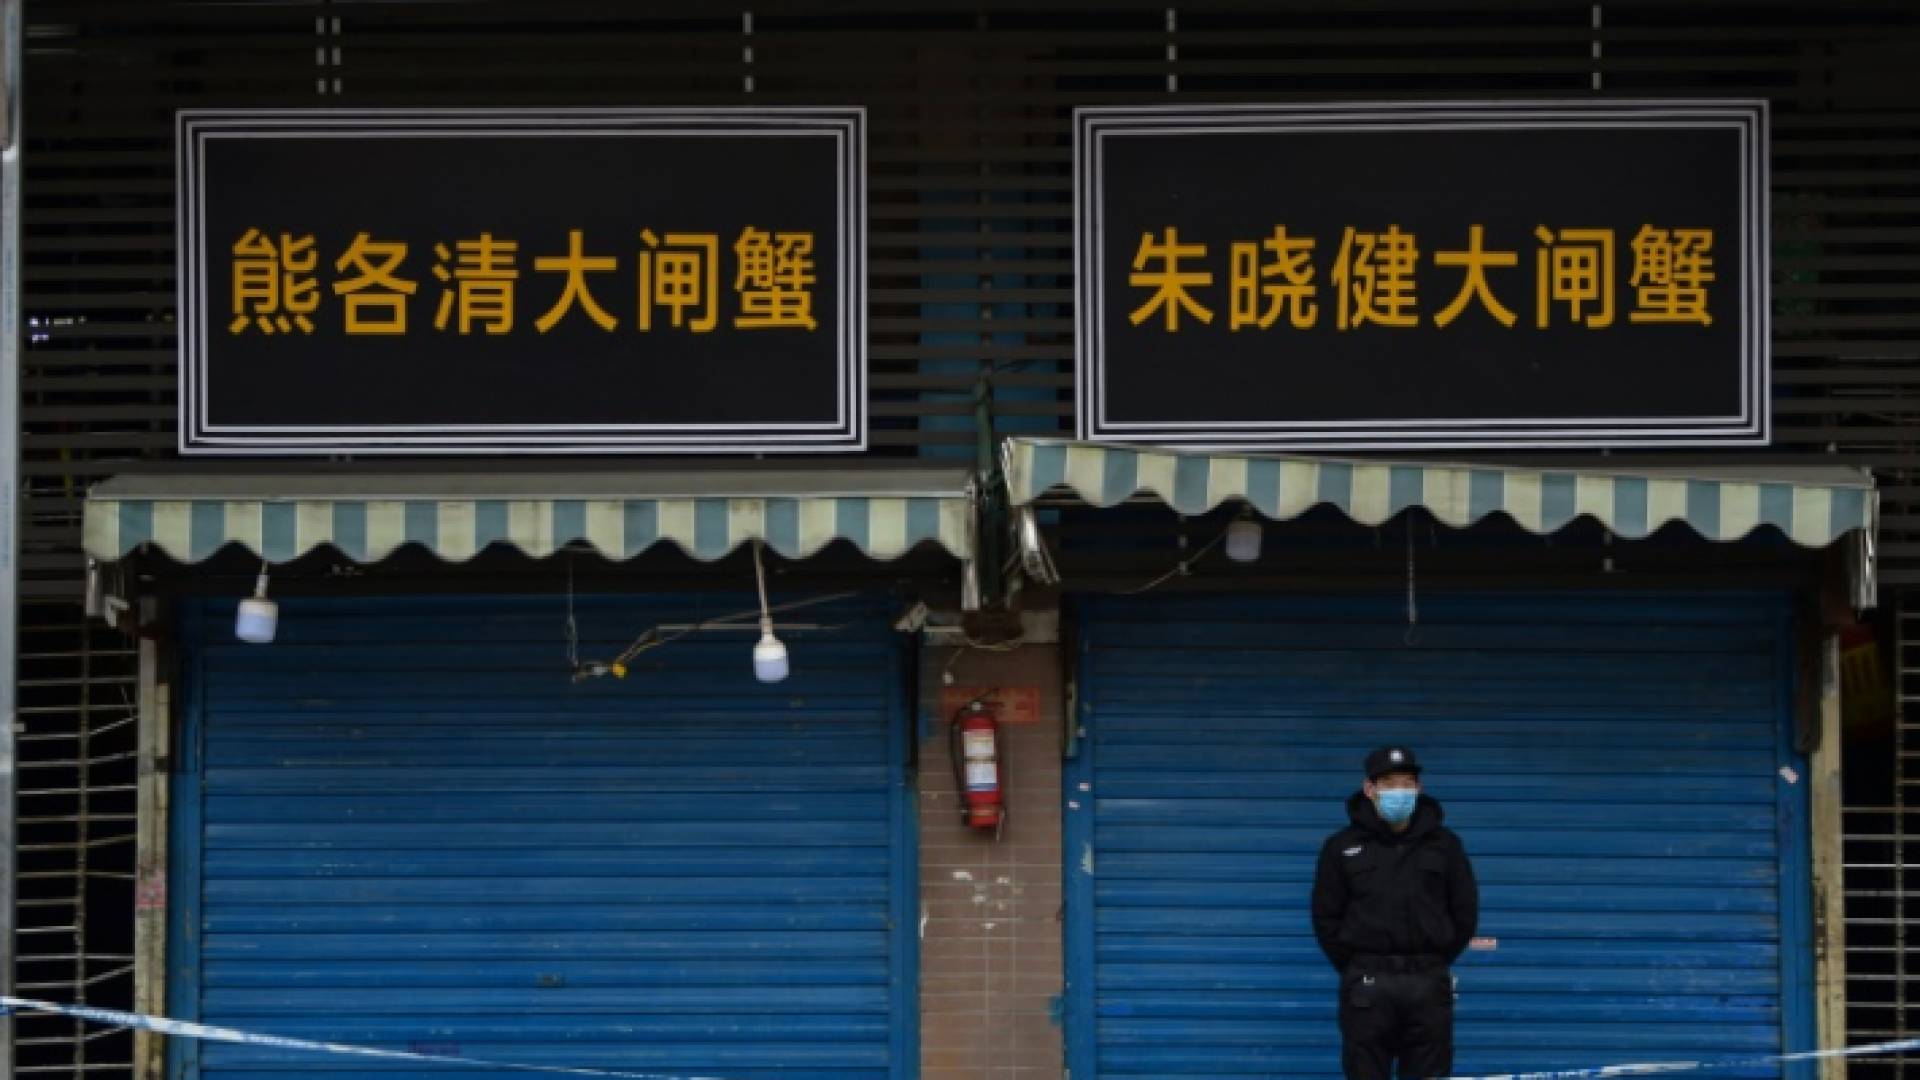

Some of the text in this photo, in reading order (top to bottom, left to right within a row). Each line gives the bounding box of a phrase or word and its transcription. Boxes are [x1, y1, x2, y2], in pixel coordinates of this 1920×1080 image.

[229, 226, 817, 335] 熊各清大闸蟹
[1129, 224, 1715, 332] 朱晓健大闸蟹
